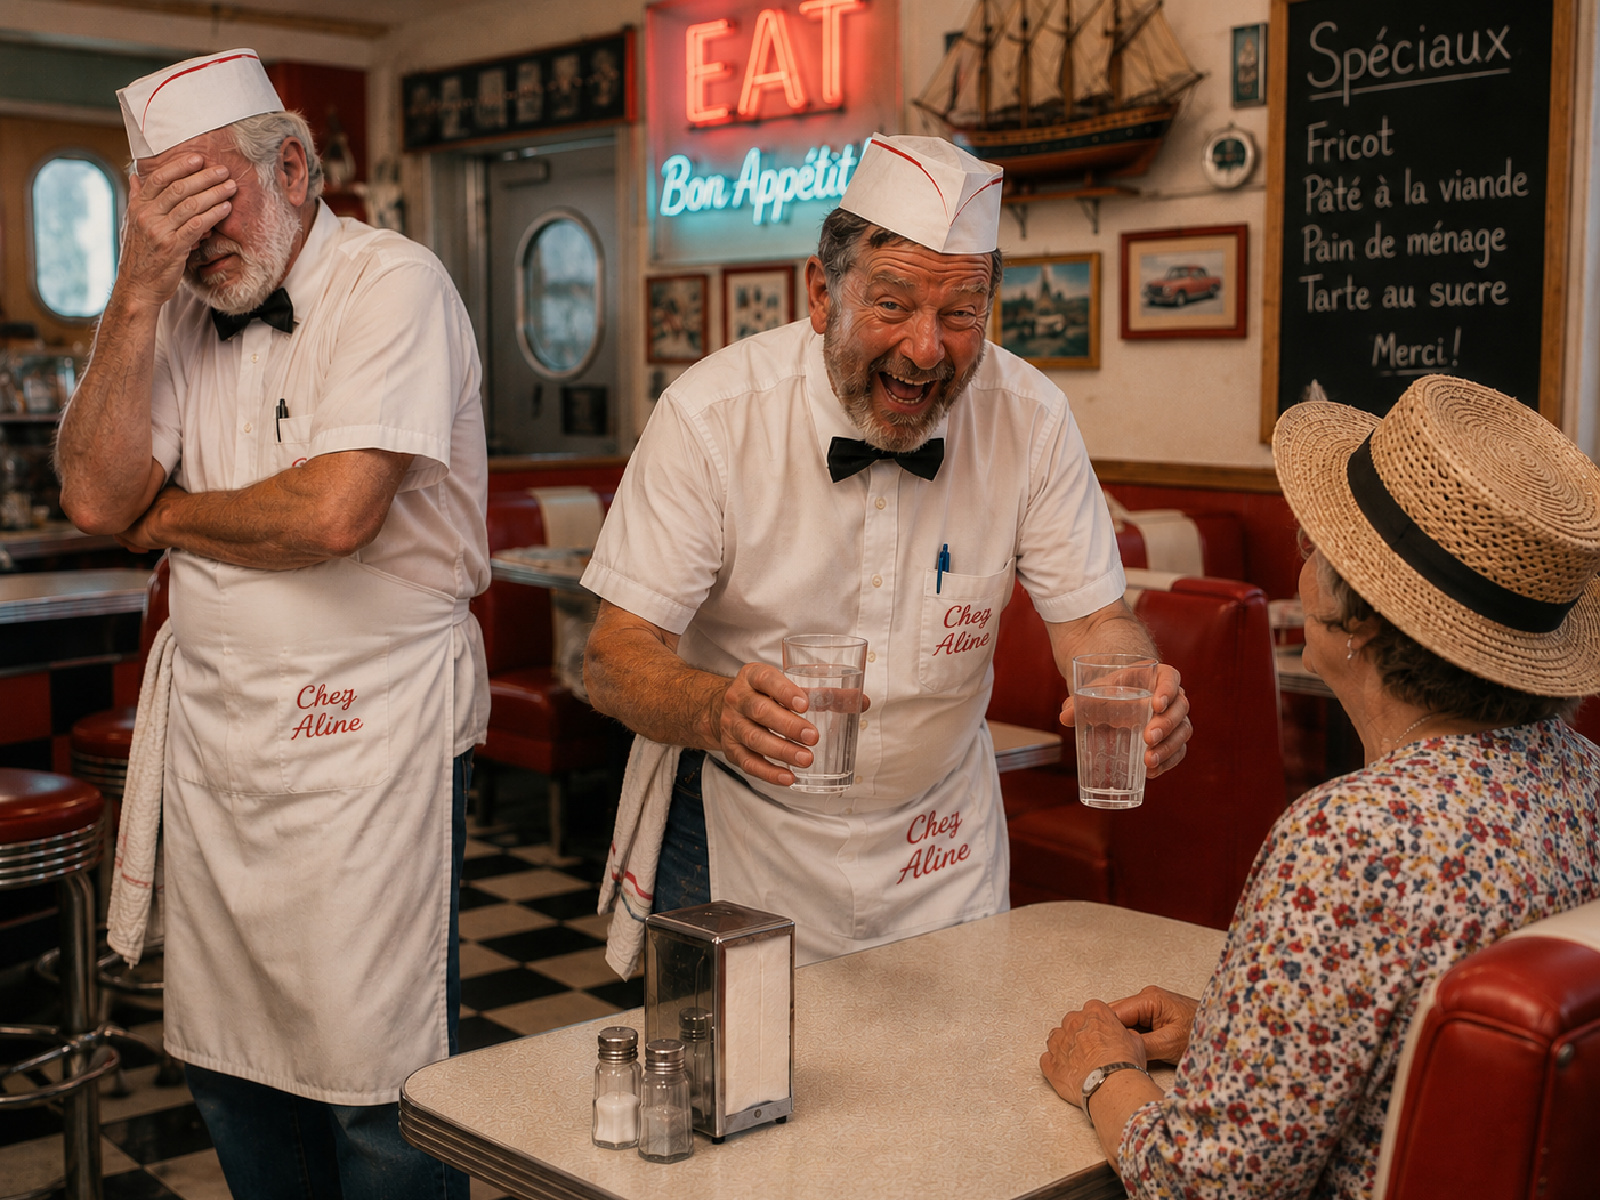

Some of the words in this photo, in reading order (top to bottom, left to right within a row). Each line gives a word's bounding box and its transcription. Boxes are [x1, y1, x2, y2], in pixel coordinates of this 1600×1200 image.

[686, 0, 867, 124] EAT
[1306, 21, 1511, 107] Spéciaux
[1307, 114, 1395, 165] Fricot
[660, 154, 730, 216] Bon
[732, 137, 872, 225] Appétit
[1304, 174, 1362, 215] Pâté
[1374, 174, 1392, 208] à
[1404, 167, 1428, 204] la
[1439, 156, 1529, 202] viande
[1302, 224, 1354, 265] Pain
[1365, 221, 1396, 259] de
[1407, 220, 1507, 269] ménage
[1299, 273, 1371, 313] Tarte
[1382, 285, 1416, 308] au
[1430, 280, 1509, 307] sucre
[932, 630, 990, 656] Aline
[291, 712, 364, 741] Aline
[896, 844, 971, 885] Aline
